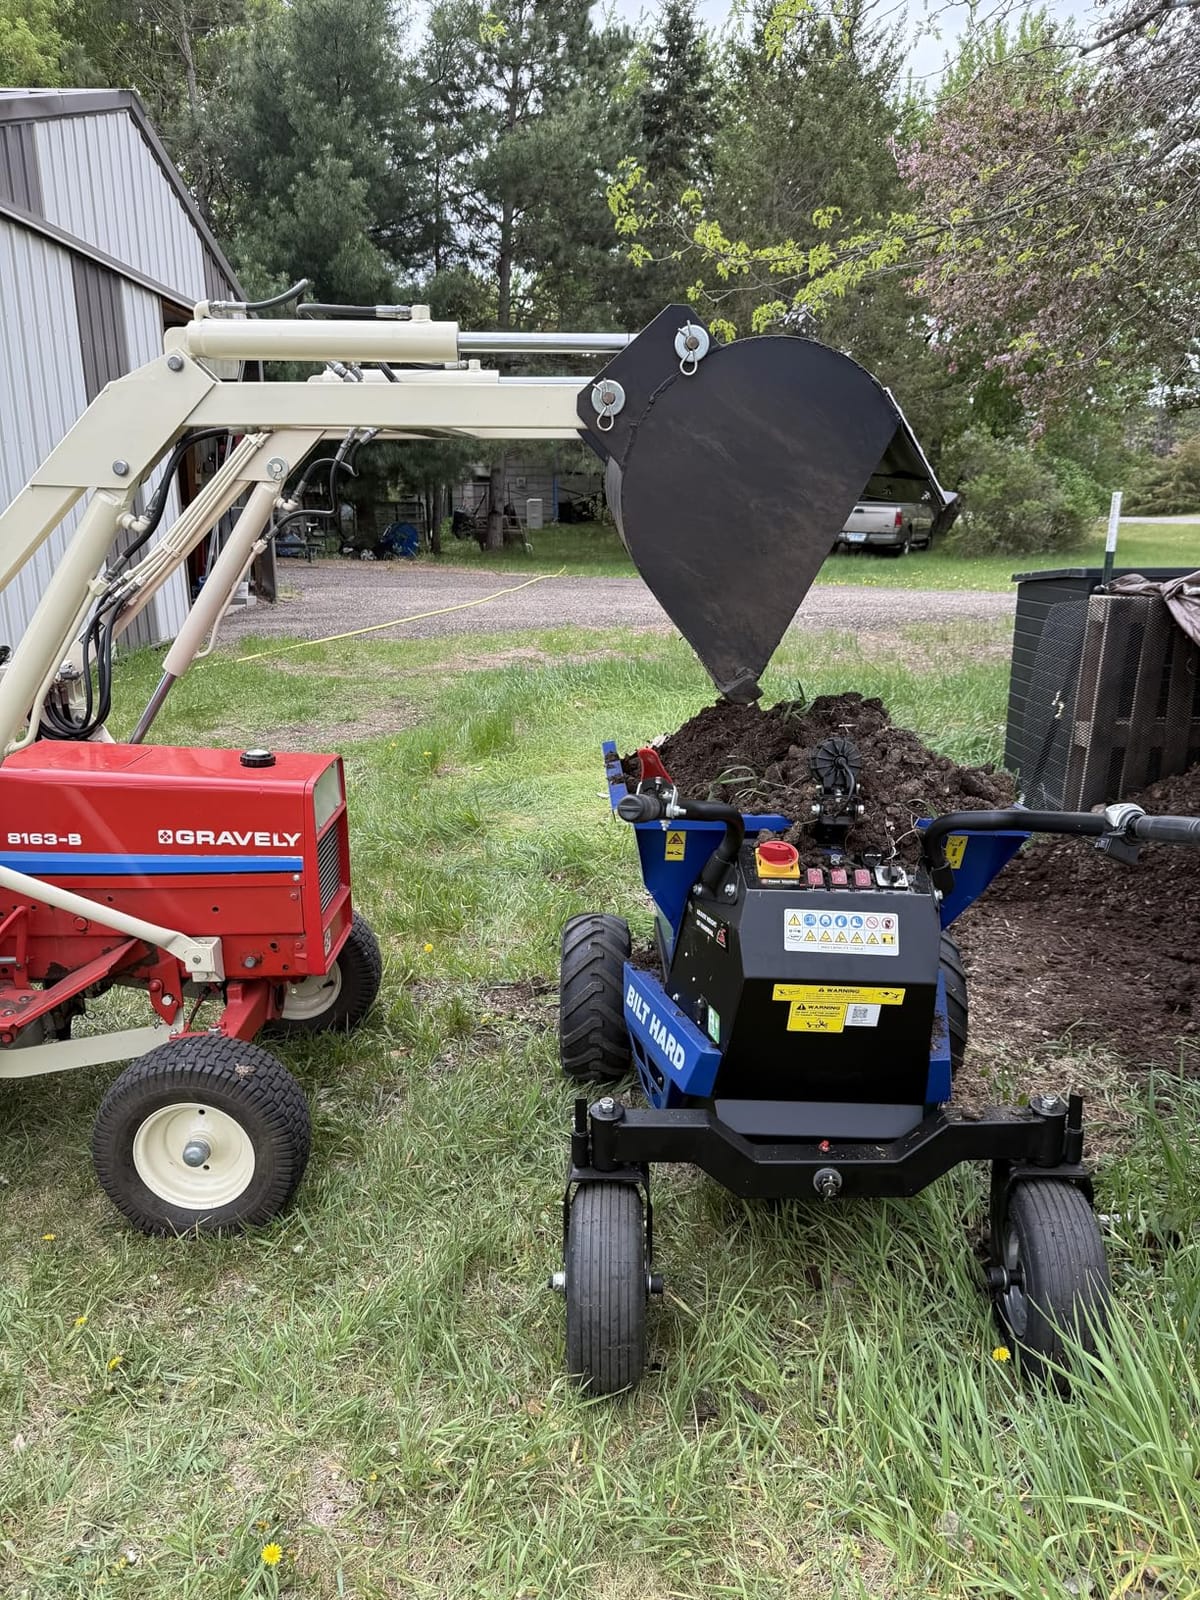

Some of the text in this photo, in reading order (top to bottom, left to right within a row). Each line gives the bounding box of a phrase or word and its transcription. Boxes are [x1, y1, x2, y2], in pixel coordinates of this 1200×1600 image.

[7, 832, 82, 846] 8163-B
[175, 830, 302, 847] GRAVELY
[626, 984, 686, 1071] BILT HARD
